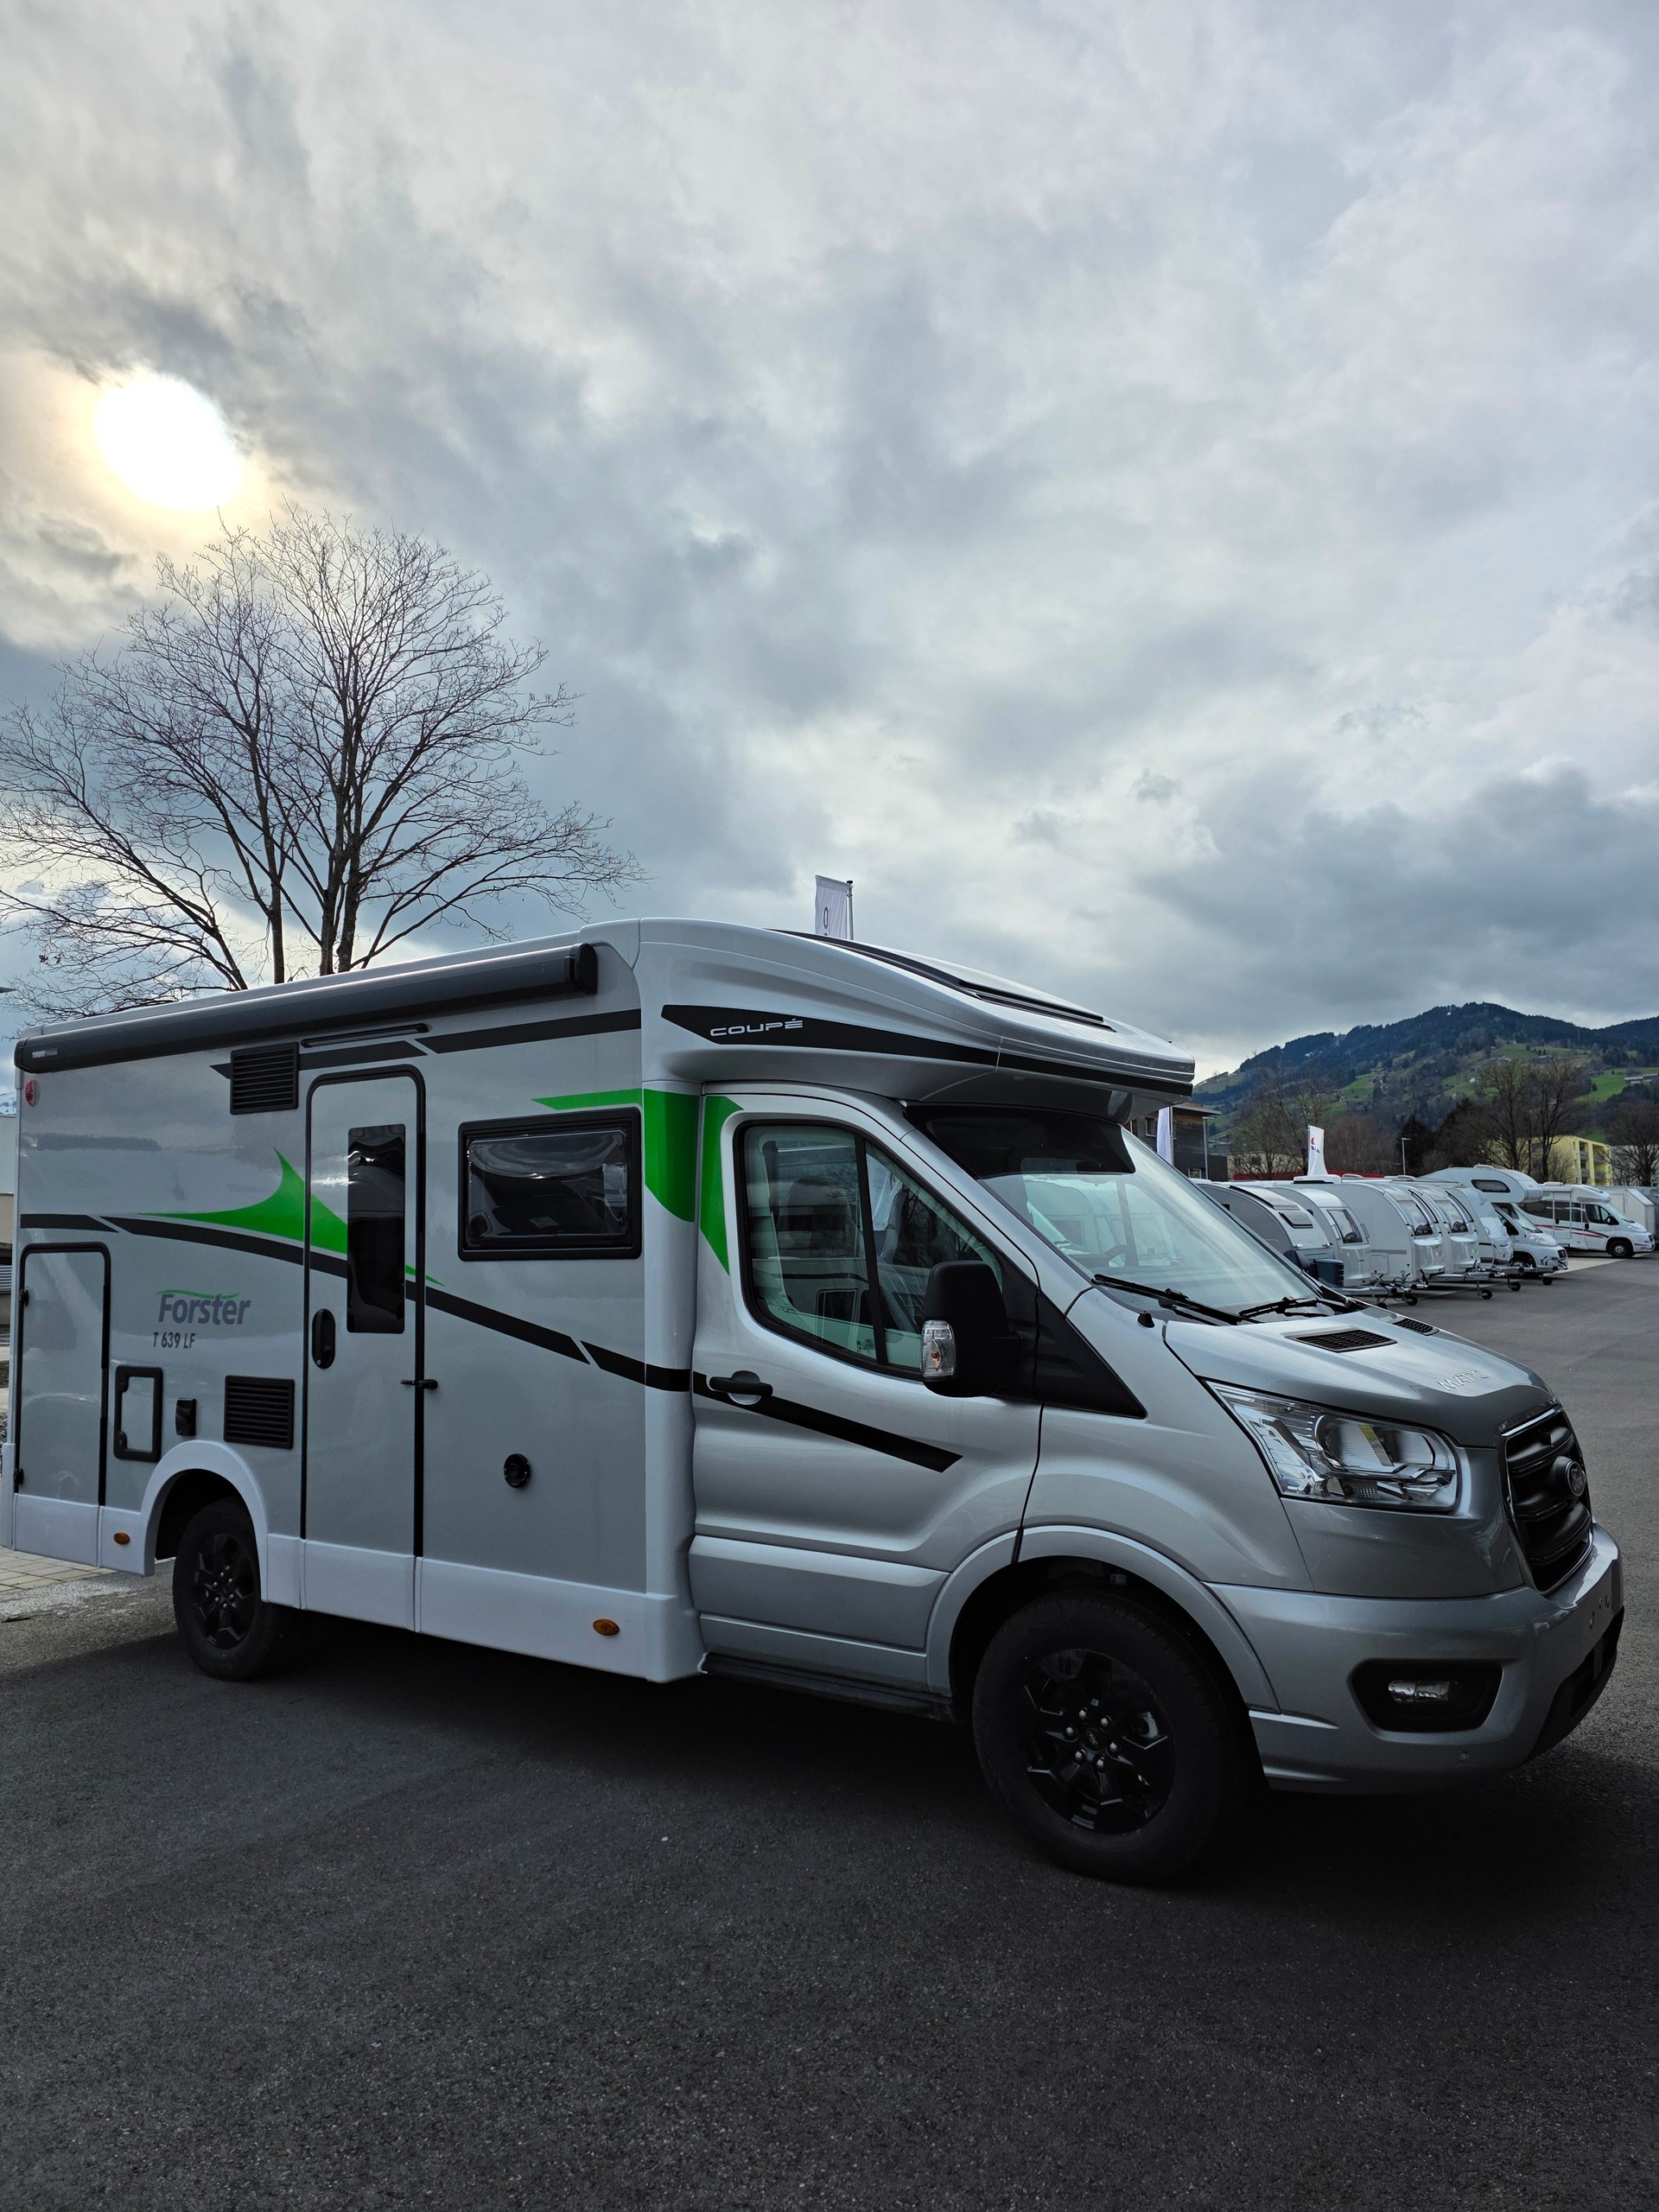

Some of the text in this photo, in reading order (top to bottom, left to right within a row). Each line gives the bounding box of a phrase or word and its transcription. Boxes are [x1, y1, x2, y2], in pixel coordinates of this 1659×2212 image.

[709, 1018, 804, 1037] COUPÉ
[158, 1294, 251, 1325] Forster
[153, 1332, 196, 1349] T 639 LF
